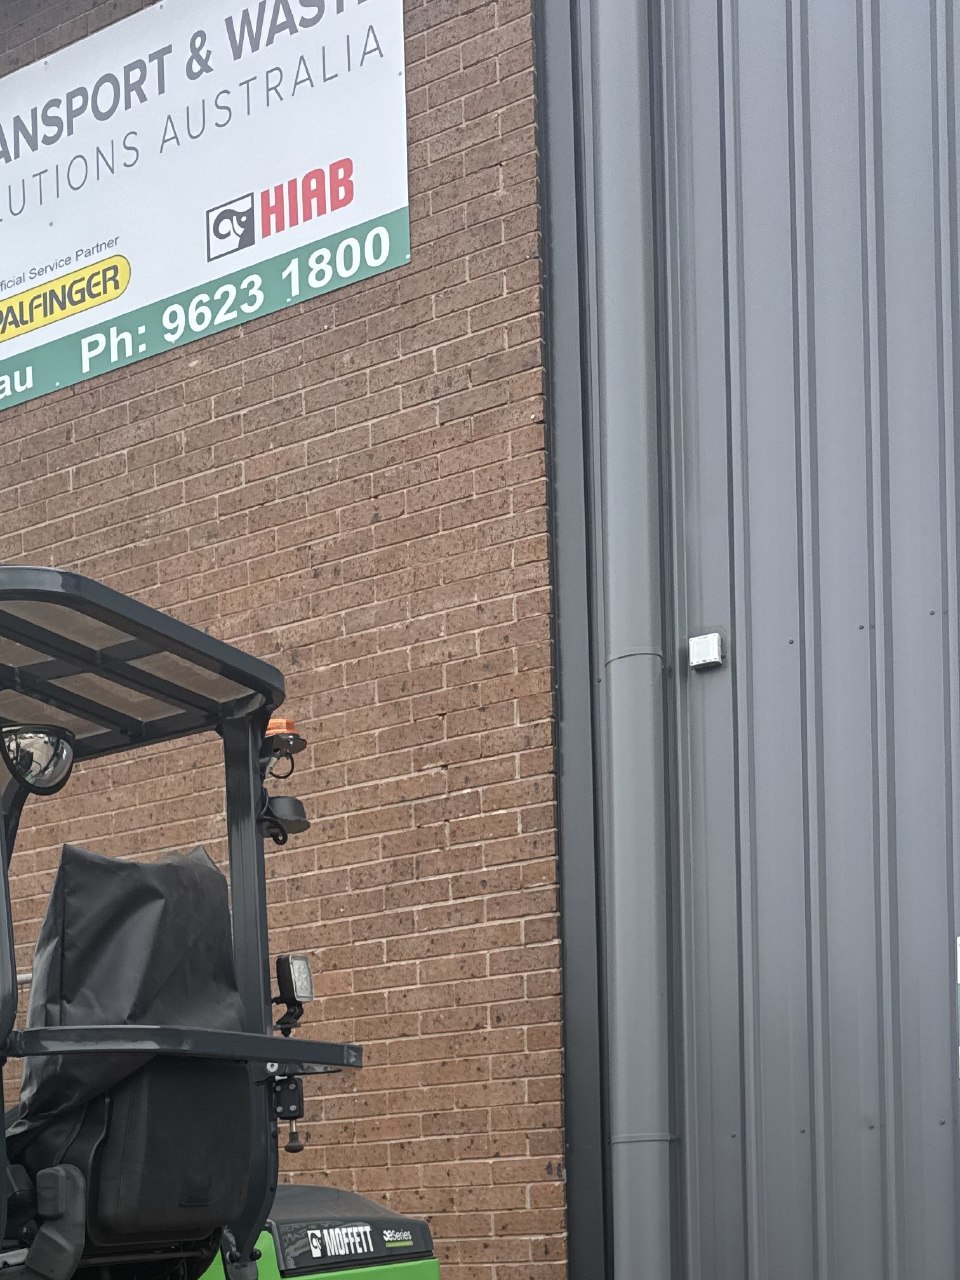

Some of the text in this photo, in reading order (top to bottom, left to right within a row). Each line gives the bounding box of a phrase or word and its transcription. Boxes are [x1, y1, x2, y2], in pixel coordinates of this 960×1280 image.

[185, 30, 213, 80] &
[224, 0, 368, 61] WAS
[159, 24, 384, 153] AUSTRALIA
[260, 157, 355, 239] HIAB
[29, 255, 73, 280] Service
[75, 236, 120, 262] Partner
[81, 324, 147, 373] Ph:
[161, 273, 265, 346] 9623
[281, 225, 391, 298] 1800
[323, 1225, 374, 1256] MOFFETT
